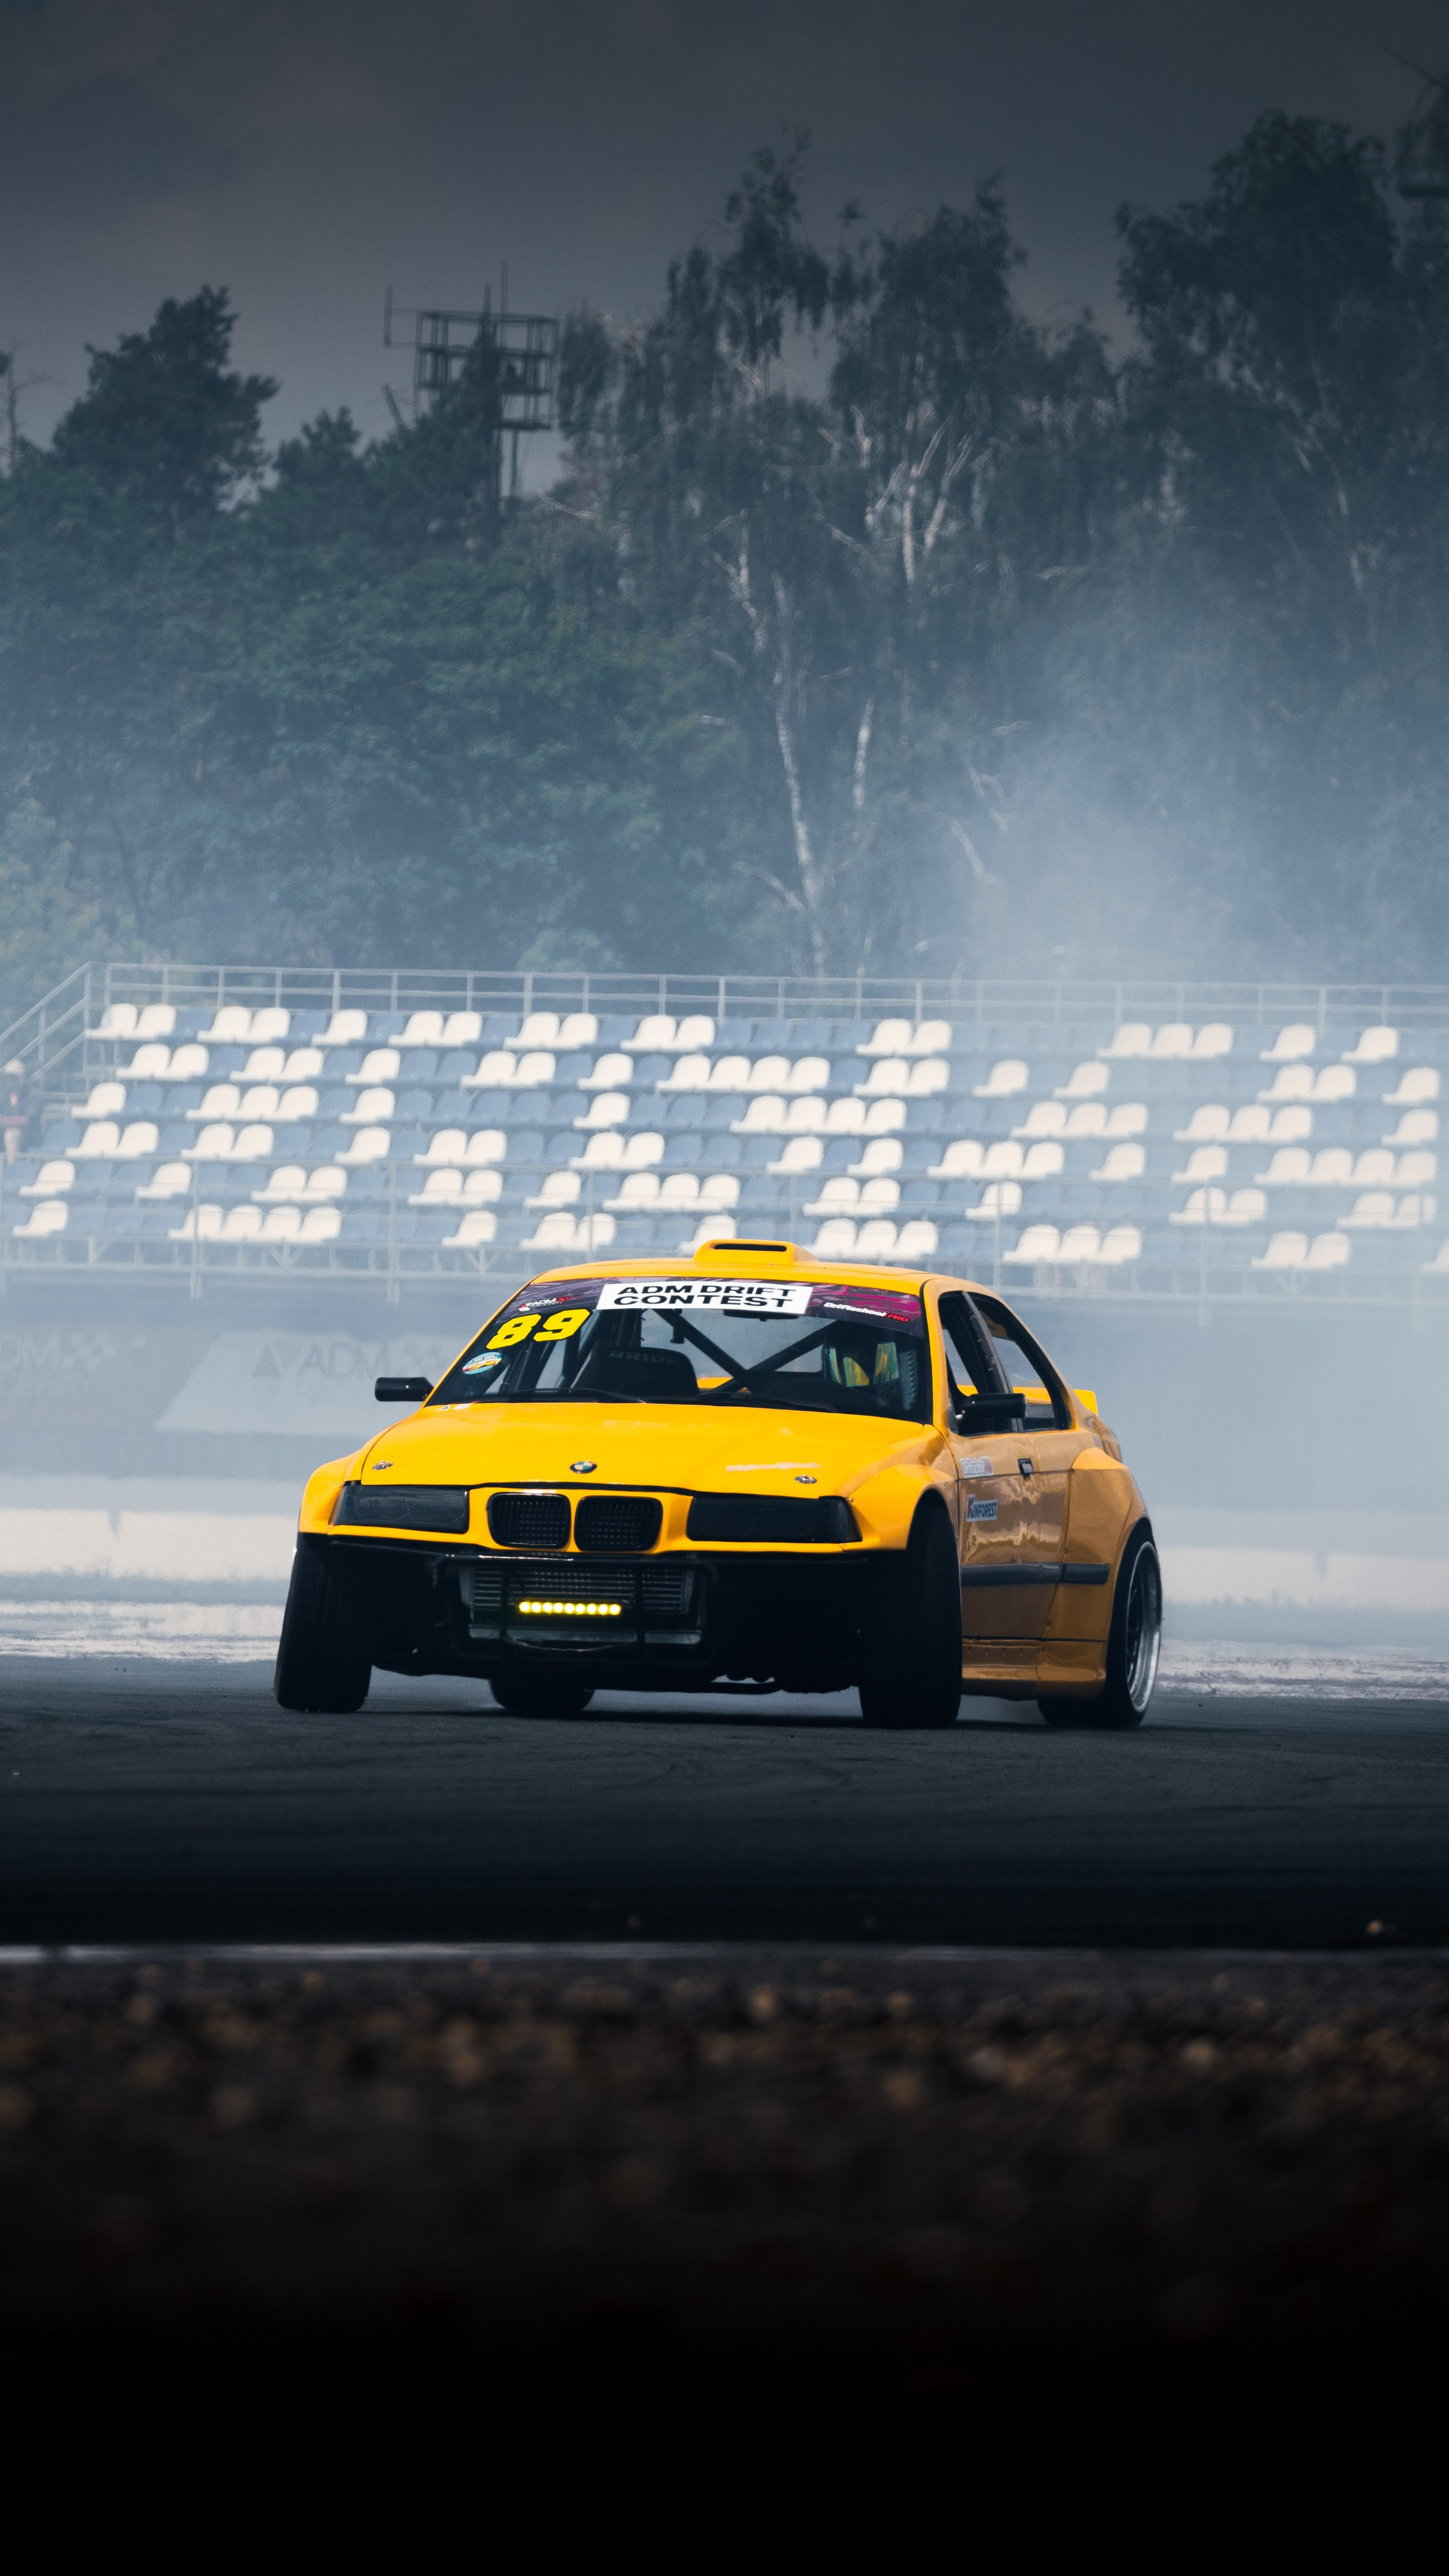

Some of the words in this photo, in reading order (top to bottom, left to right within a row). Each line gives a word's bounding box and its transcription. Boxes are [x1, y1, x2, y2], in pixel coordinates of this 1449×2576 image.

[617, 1285, 692, 1295] ADM
[700, 1285, 797, 1297] DRIFT
[531, 1297, 557, 1307] ADM
[614, 1295, 792, 1308] CONTEST
[486, 1309, 591, 1350] 89
[297, 1341, 389, 1379] ADM
[609, 1351, 680, 1367] BRIDE
[967, 1496, 997, 1519] KINFOREST
